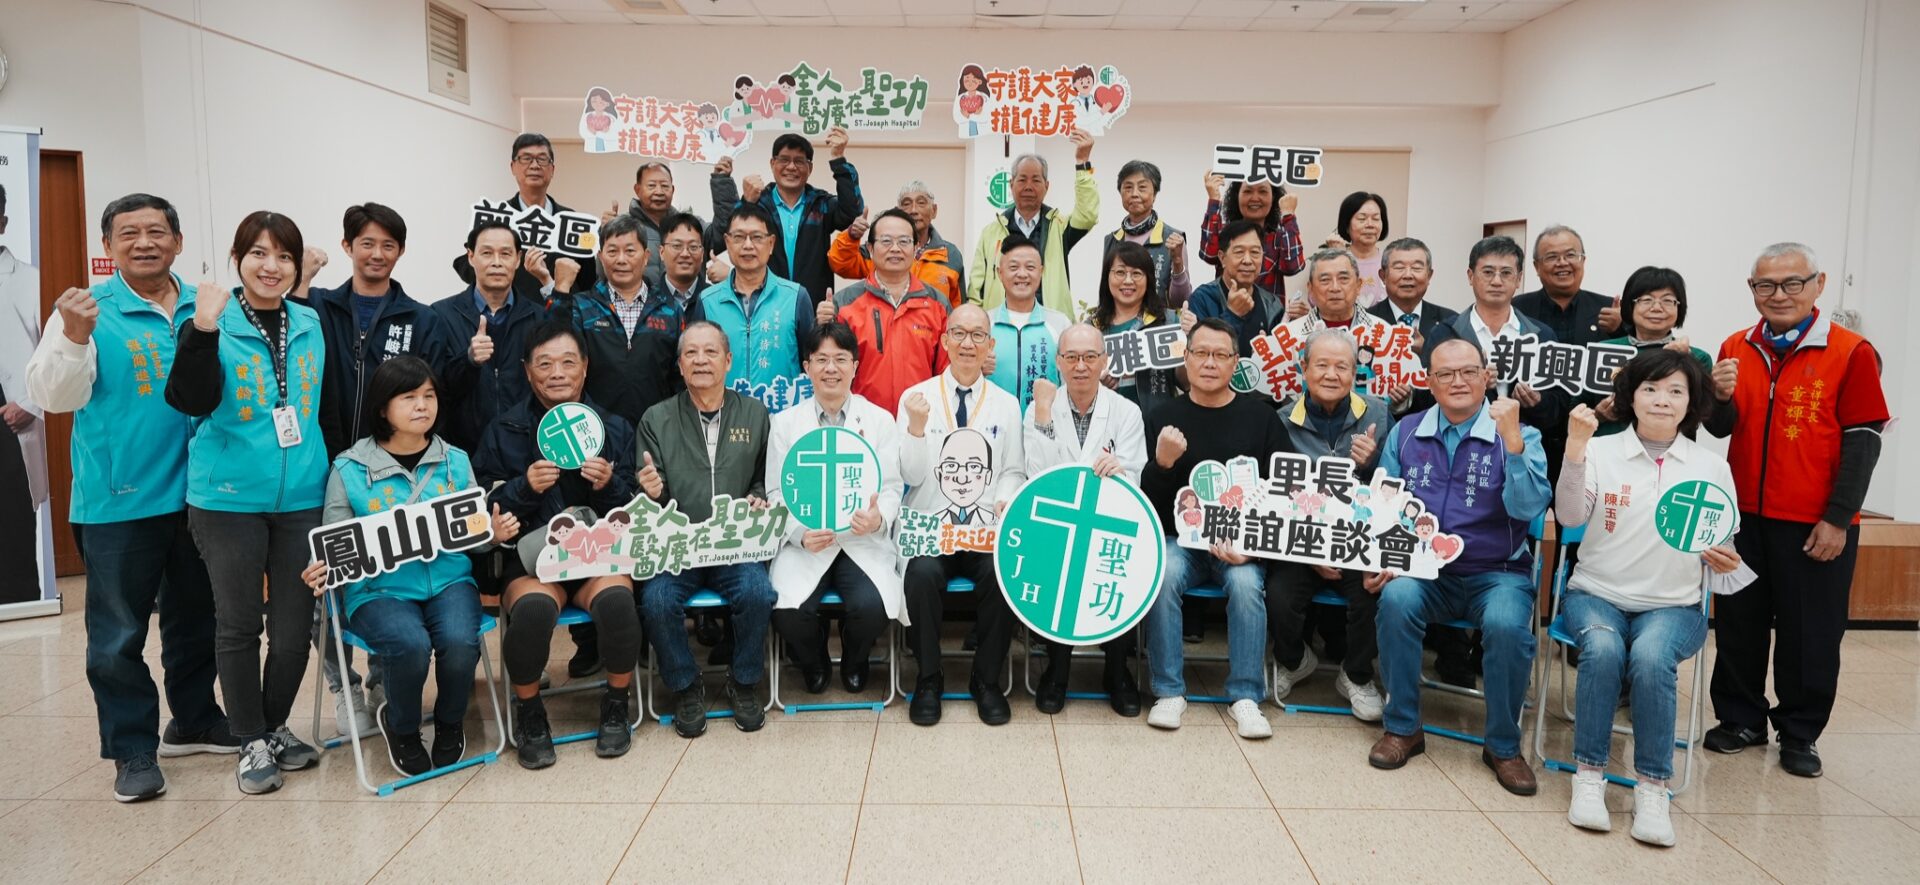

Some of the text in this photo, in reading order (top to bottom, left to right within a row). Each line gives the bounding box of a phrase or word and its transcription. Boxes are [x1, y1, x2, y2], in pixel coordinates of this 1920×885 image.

[789, 63, 842, 96] 全人
[986, 66, 1078, 105] 守護大家
[614, 94, 704, 132] 守護大家
[854, 119, 920, 128] ST.Joseph Hospital
[990, 102, 1076, 136] 攏健康
[618, 127, 706, 161] 攏健康
[1211, 146, 1321, 185] 三民區
[1104, 325, 1184, 373] 雅區
[1353, 322, 1413, 361] 健康
[1267, 366, 1302, 401] 我
[1491, 335, 1634, 394] 新興區
[543, 443, 569, 464] SJH
[575, 420, 598, 450] 聖功
[842, 466, 862, 515] 聖功
[1268, 456, 1354, 505] 里長
[1465, 452, 1479, 507] 里長聯誼會
[1479, 455, 1492, 488] 鳳山區
[786, 473, 811, 516] SJH
[1619, 484, 1632, 508] 里長
[625, 496, 690, 534] 全人
[900, 507, 940, 532] 聖功
[1659, 505, 1676, 538] SJH
[1697, 510, 1721, 546] 聖功
[312, 490, 491, 586] 鳳山區
[698, 548, 776, 563] ST.Joseph Hospital
[899, 524, 996, 557] 醫院 歡迎
[1201, 504, 1420, 571] 聯誼座談會
[1007, 528, 1041, 604] SJH
[1089, 537, 1133, 621] 聖功
